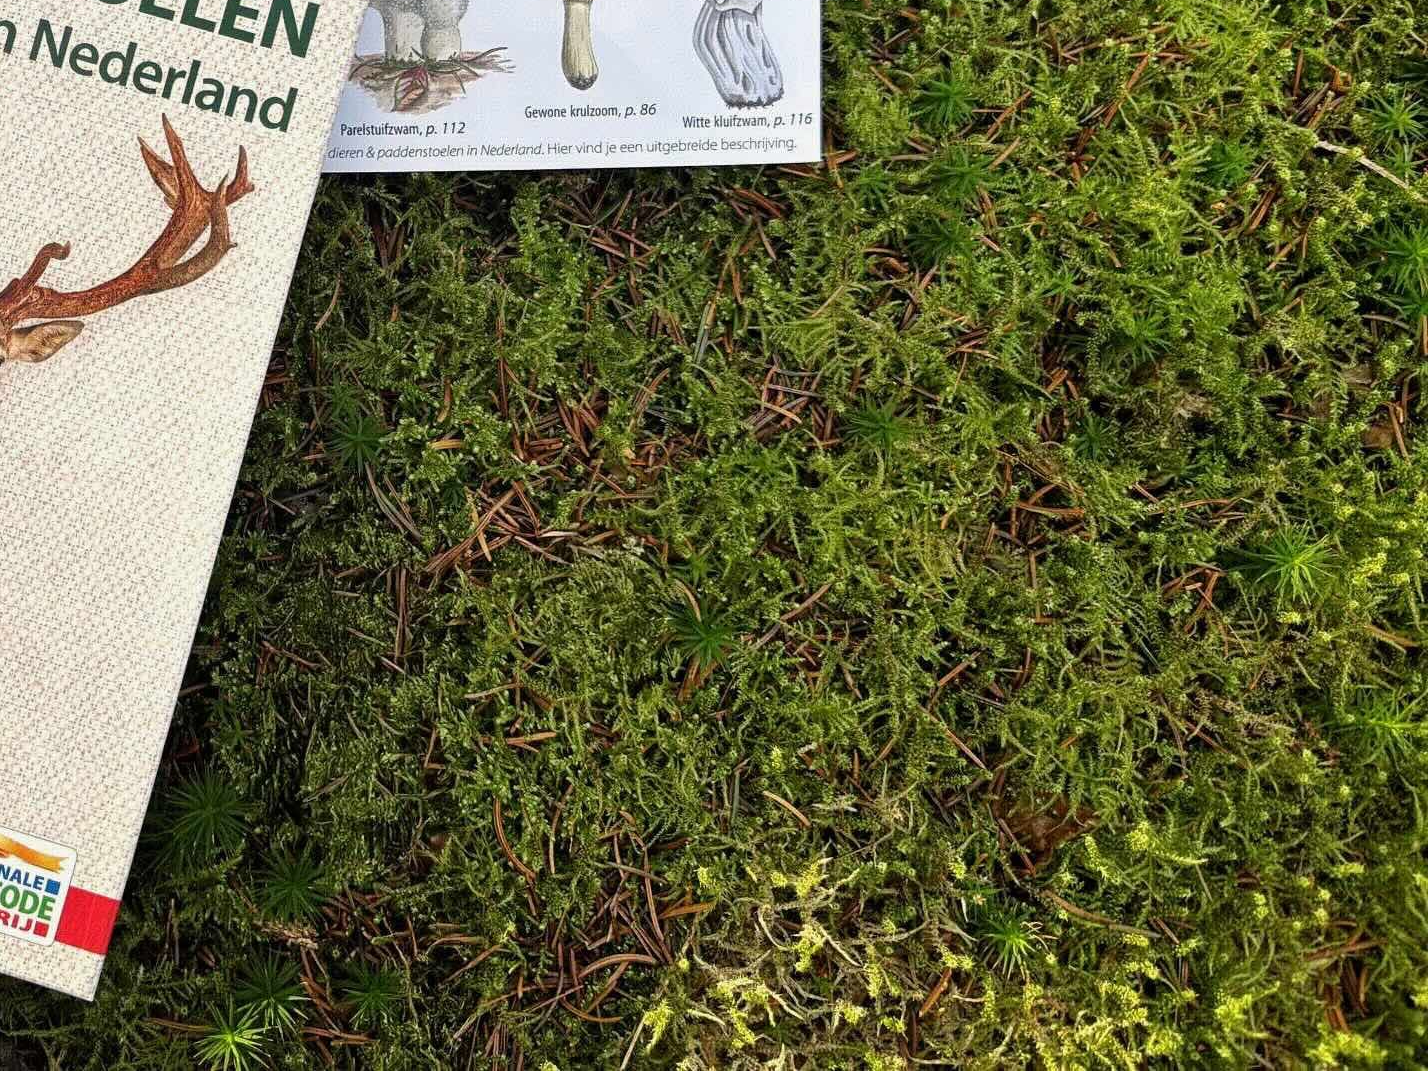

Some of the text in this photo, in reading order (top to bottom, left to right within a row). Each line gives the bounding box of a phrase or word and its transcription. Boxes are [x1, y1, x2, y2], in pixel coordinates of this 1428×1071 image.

[29, 19, 299, 133] Nederland
[524, 103, 657, 120] Gewone krulzoom, p. 86
[683, 112, 812, 129] Witte kluifzwam, p. 116
[340, 122, 465, 137] Parelstuifzwam, p. 112
[328, 137, 797, 159] dieren & paddenstoelen in Nederland. Hier vind je een uitgebreide beschrijving.
